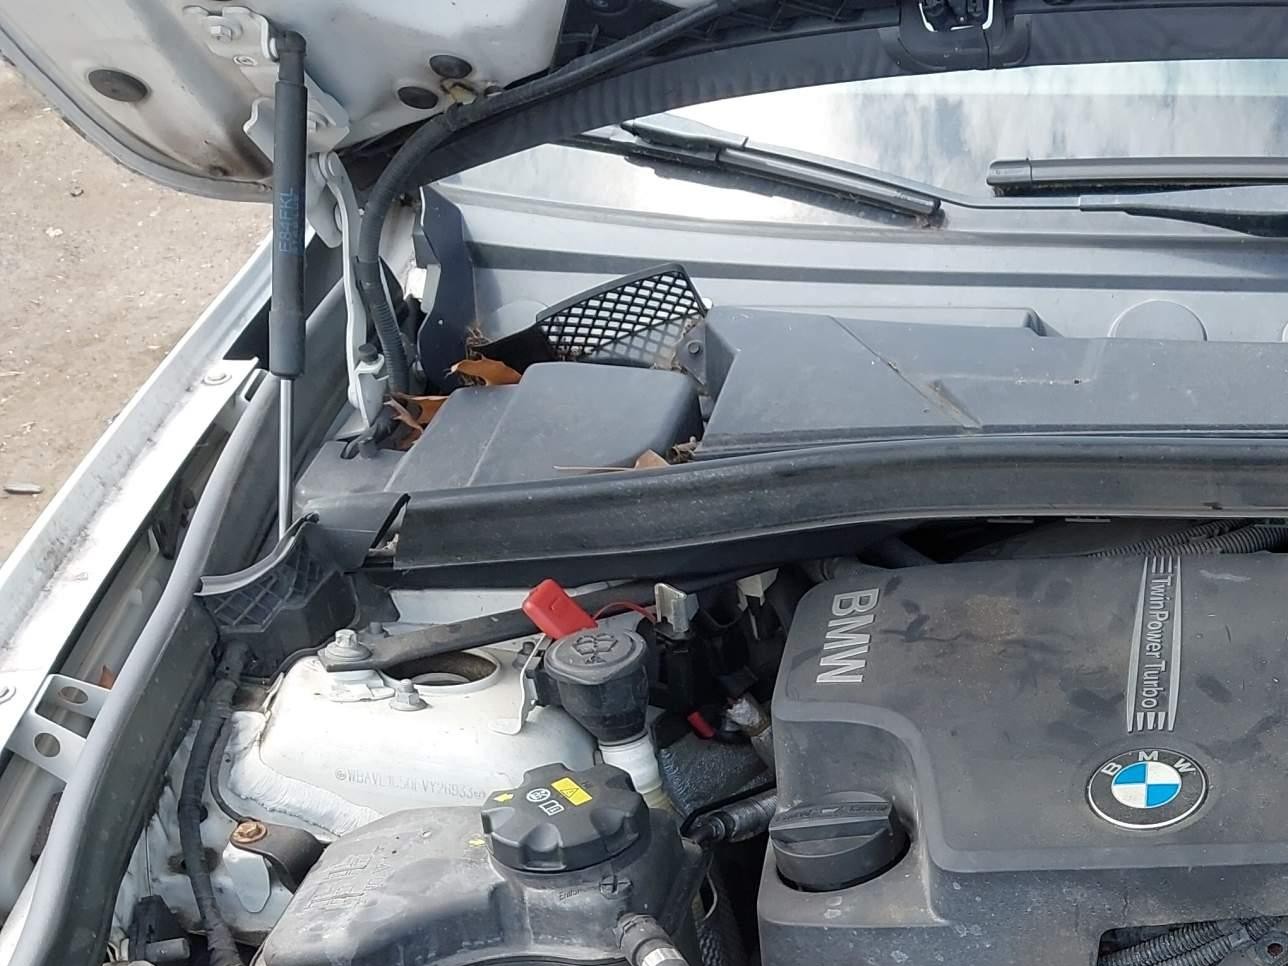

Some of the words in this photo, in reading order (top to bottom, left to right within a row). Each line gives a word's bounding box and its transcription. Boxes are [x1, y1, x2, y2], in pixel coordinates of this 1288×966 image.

[816, 588, 879, 683] BMW
[1145, 575, 1171, 658] TwinPower
[1141, 660, 1166, 709] Turbo
[1101, 750, 1196, 777] BMW
